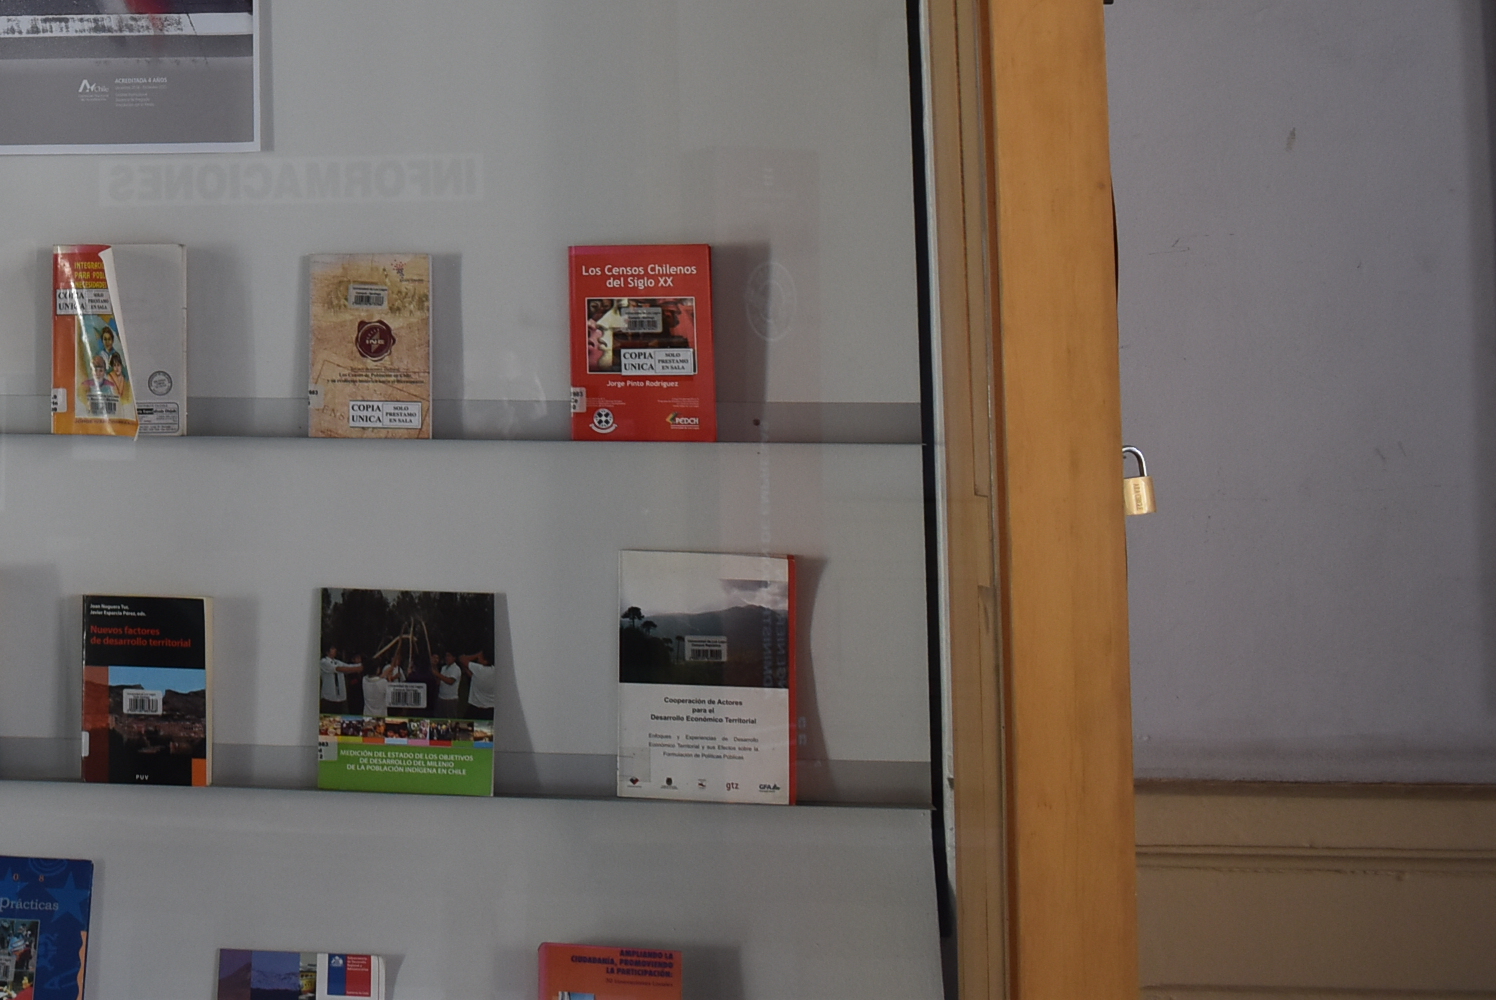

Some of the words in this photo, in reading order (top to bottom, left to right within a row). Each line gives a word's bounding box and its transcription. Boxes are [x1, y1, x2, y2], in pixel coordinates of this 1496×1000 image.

[582, 265, 602, 276] Los
[604, 264, 645, 276] Censos
[647, 264, 697, 275] Chilenos
[606, 277, 625, 288] del
[627, 277, 655, 290] Siglo
[658, 276, 674, 287] XX
[623, 351, 654, 360] COPIA
[624, 363, 655, 371] UNICA
[606, 380, 625, 388] Jorge
[351, 404, 382, 412] COPIA
[351, 415, 382, 423] UNICA
[90, 625, 123, 634] Nuevos
[124, 625, 160, 636] factores
[90, 636, 102, 645] de
[103, 636, 148, 646] desarrollo
[149, 638, 192, 648] territorial
[664, 697, 706, 705] Cooperación
[686, 715, 723, 723] Económico
[725, 716, 757, 724] Territorial
[340, 749, 373, 757] MEDICIÓN
[439, 754, 474, 762] OBJETIVOS
[370, 758, 413, 766] DESARROLLO
[426, 760, 455, 768] MILENIO
[366, 763, 404, 773] POBLACIÓN
[726, 782, 739, 791] gtz
[619, 950, 663, 960] AMPLIANDO
[664, 952, 673, 960] LA
[619, 958, 673, 969] PROMOVIENDO
[606, 967, 615, 975] LA
